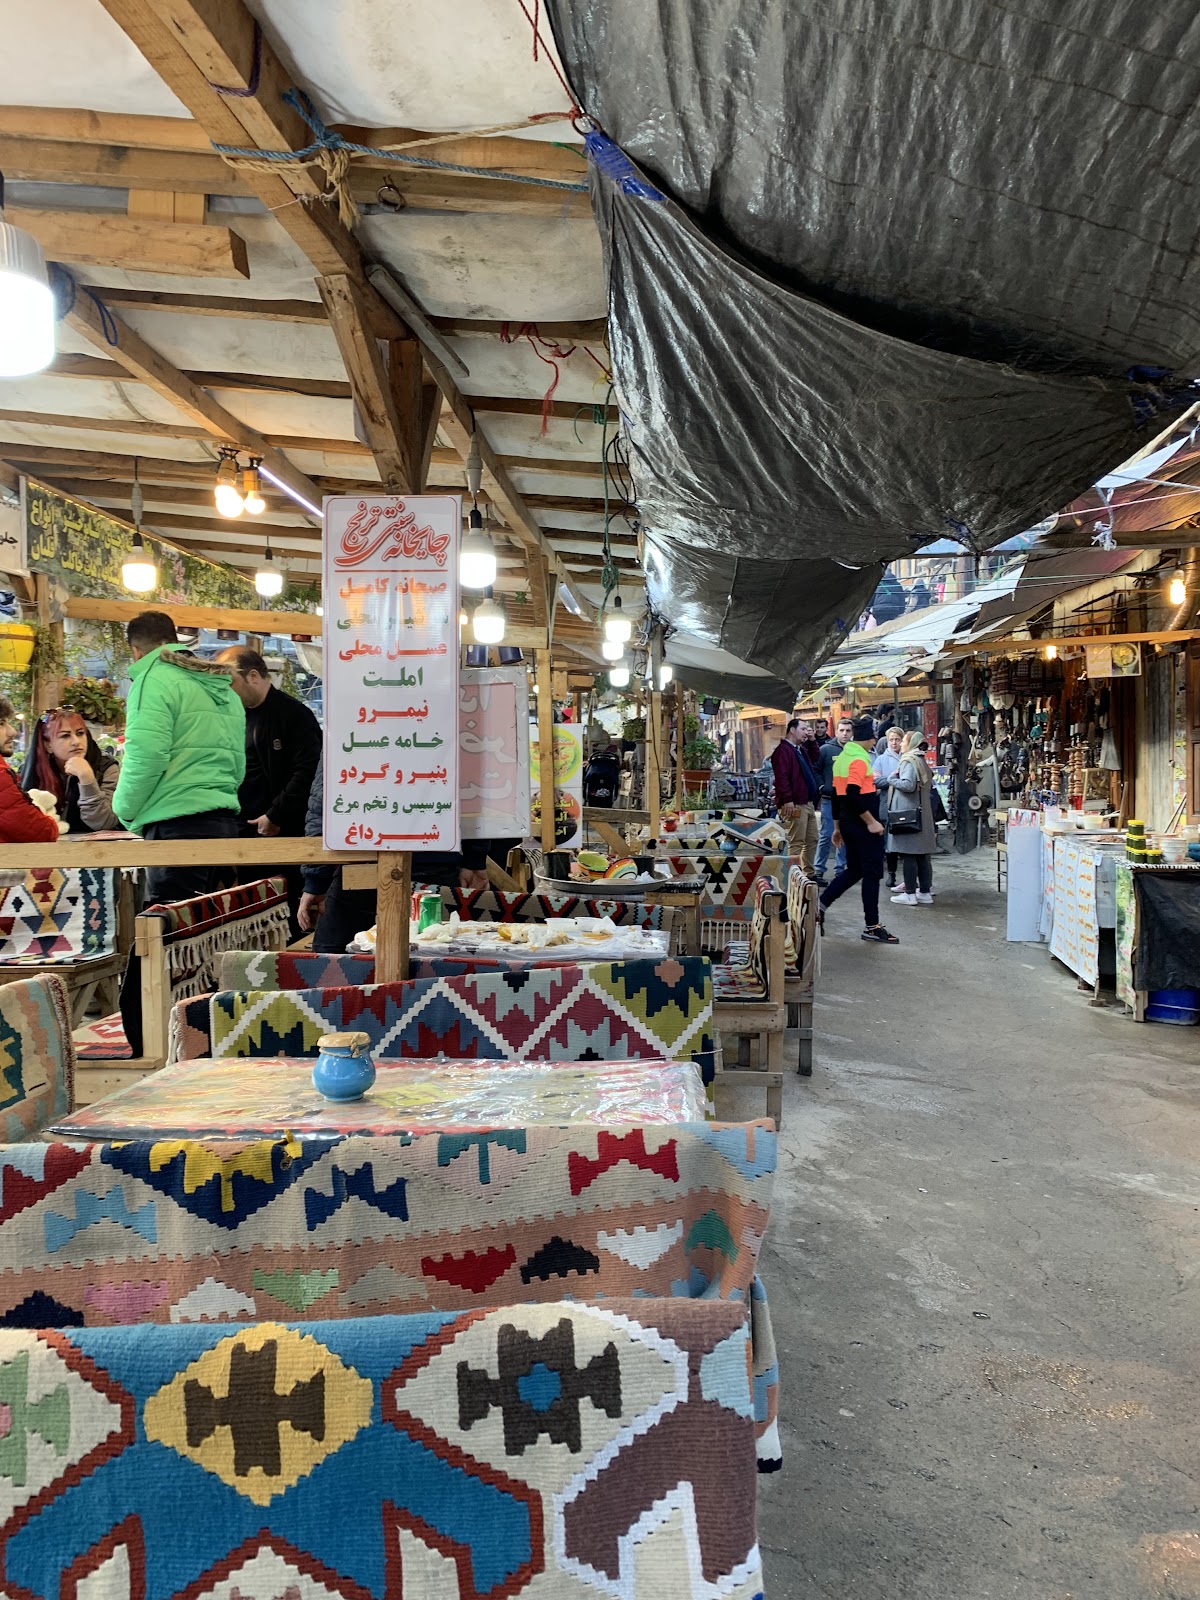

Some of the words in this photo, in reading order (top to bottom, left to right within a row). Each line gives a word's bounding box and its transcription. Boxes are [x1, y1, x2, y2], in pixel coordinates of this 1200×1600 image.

[334, 500, 415, 567] سنتی
[341, 500, 382, 555] ترنج
[382, 523, 450, 566] چایخانه
[339, 577, 390, 599] کامل
[395, 577, 448, 595] صبحانه
[339, 639, 382, 661] محلی
[387, 640, 448, 661] عسل
[362, 666, 423, 688] املت
[357, 699, 429, 724] نیمرو
[342, 731, 390, 753] عسل
[395, 731, 444, 749] خامه
[338, 763, 390, 784] گردو
[394, 769, 404, 784] و
[407, 765, 448, 785] پنیر
[332, 794, 359, 814] مرغ
[363, 795, 388, 814] تخم
[391, 801, 399, 814] و
[402, 801, 452, 815] سوسیس
